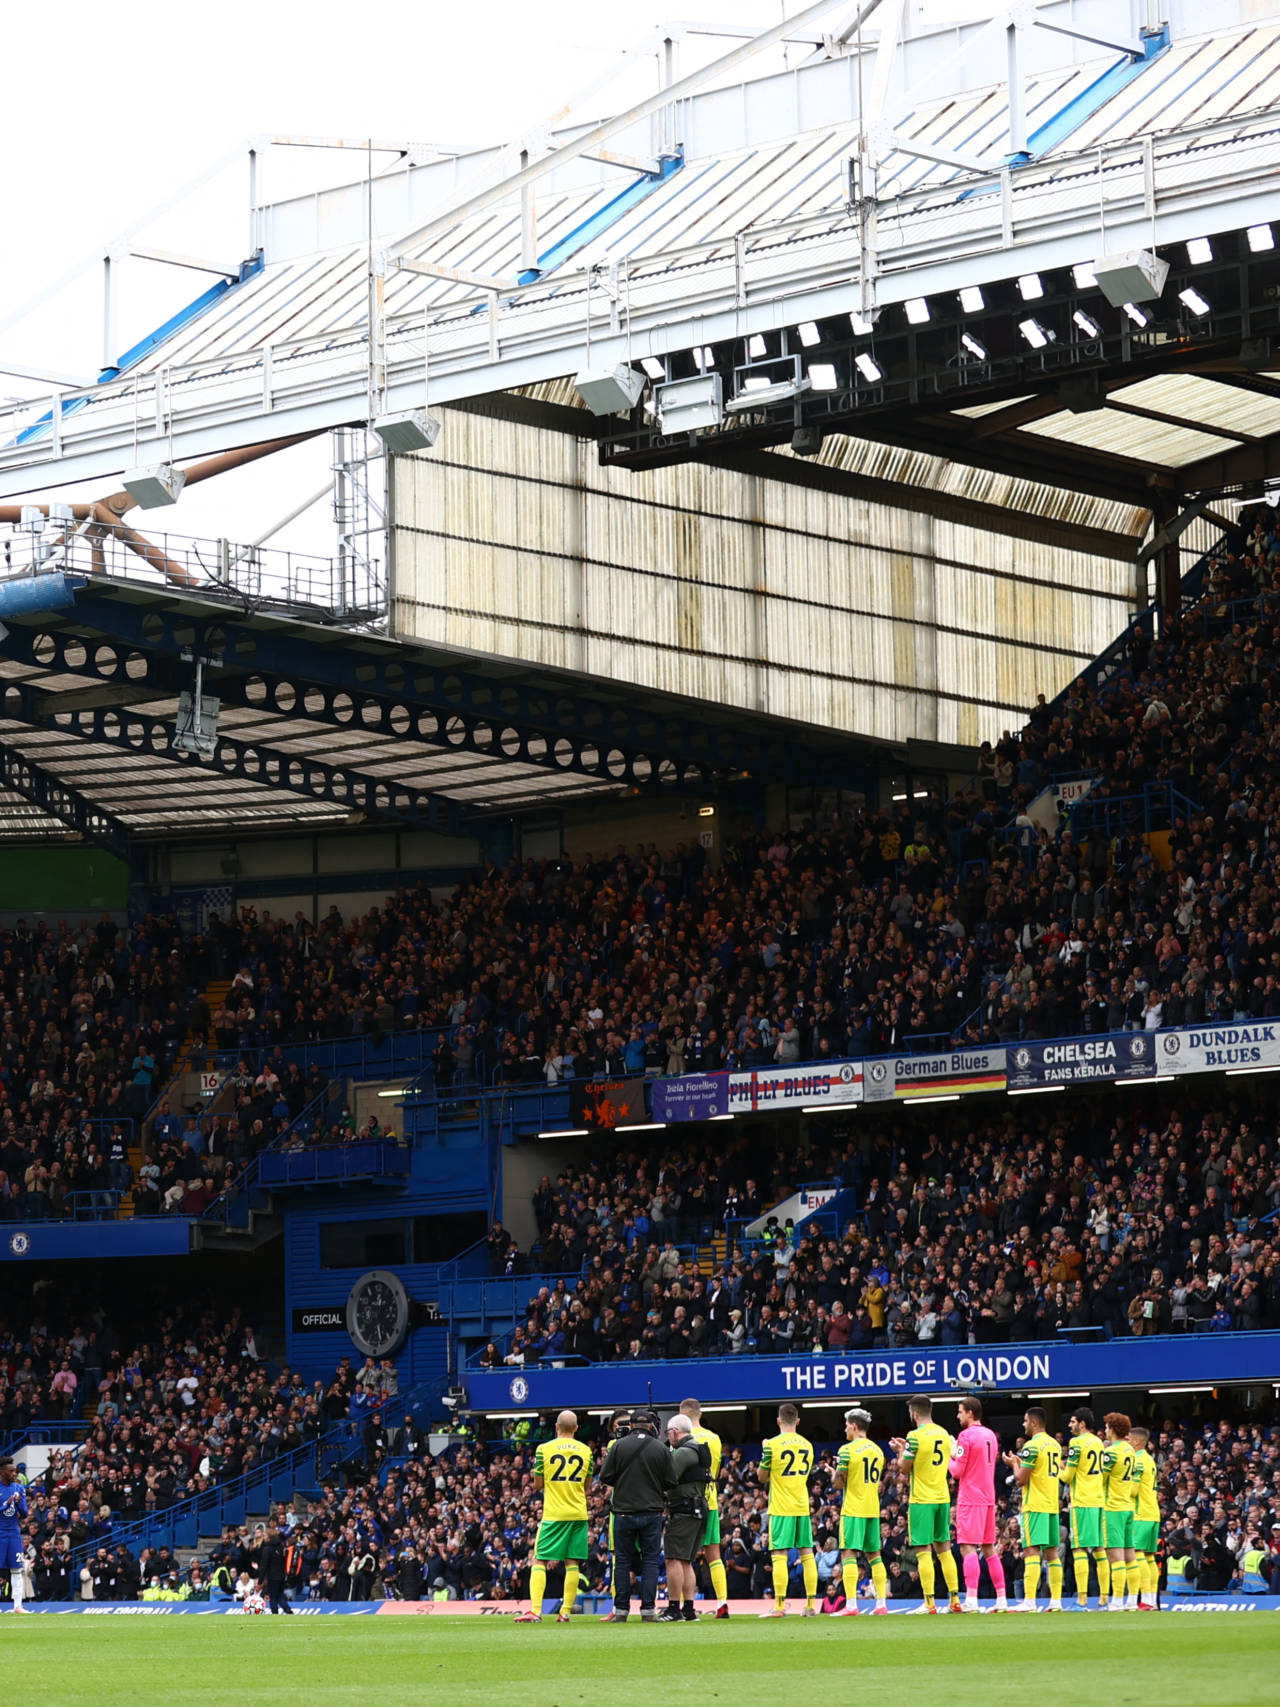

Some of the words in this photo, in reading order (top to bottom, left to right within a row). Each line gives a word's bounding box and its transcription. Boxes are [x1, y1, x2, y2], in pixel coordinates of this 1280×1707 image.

[1062, 786, 1074, 799] EU
[1189, 1026, 1276, 1048] DUNDALK
[1043, 1041, 1116, 1064] CHELSEA
[1206, 1047, 1261, 1066] BLUES
[895, 1059, 947, 1076] German
[951, 1055, 989, 1071] Blues
[1044, 1068, 1073, 1080] FANS
[1074, 1064, 1116, 1078] KERALA
[202, 1075, 218, 1089] 16
[729, 1079, 779, 1102] PHILLY
[783, 1075, 831, 1097] BLUES
[302, 1313, 343, 1326] OFFICIAL
[781, 1365, 826, 1390] THE
[834, 1362, 906, 1388] PRIDE
[912, 1360, 937, 1377] OF
[943, 1355, 1050, 1382] LONDON
[780, 1449, 810, 1477] 23
[932, 1440, 943, 1466] 5
[986, 1441, 991, 1463] 1
[550, 1454, 584, 1482] 22
[862, 1457, 880, 1483] 16
[1047, 1451, 1059, 1477] 15
